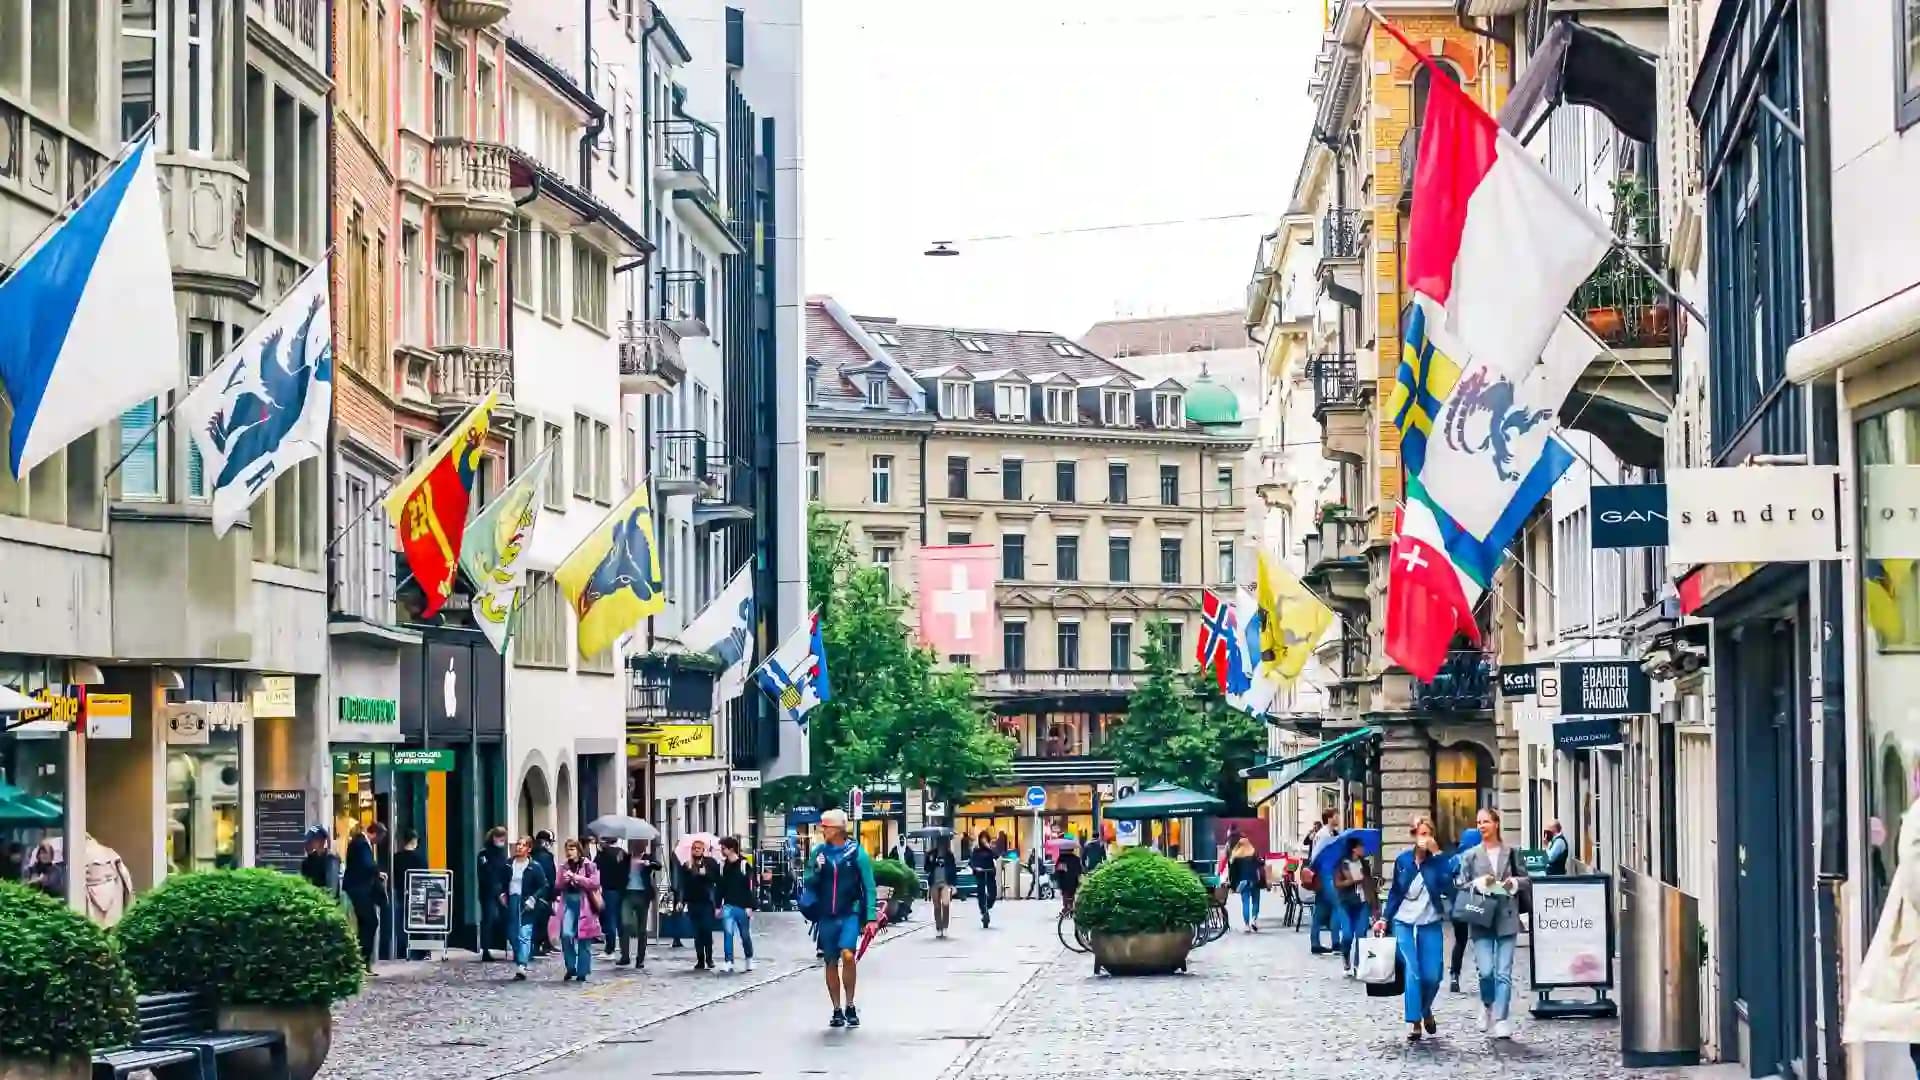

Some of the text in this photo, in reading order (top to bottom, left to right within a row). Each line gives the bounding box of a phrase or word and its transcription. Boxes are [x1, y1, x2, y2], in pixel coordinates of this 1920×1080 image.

[1682, 504, 1825, 524] sandro
[1589, 667, 1629, 687] BARBER
[1583, 688, 1629, 709] PARADOX
